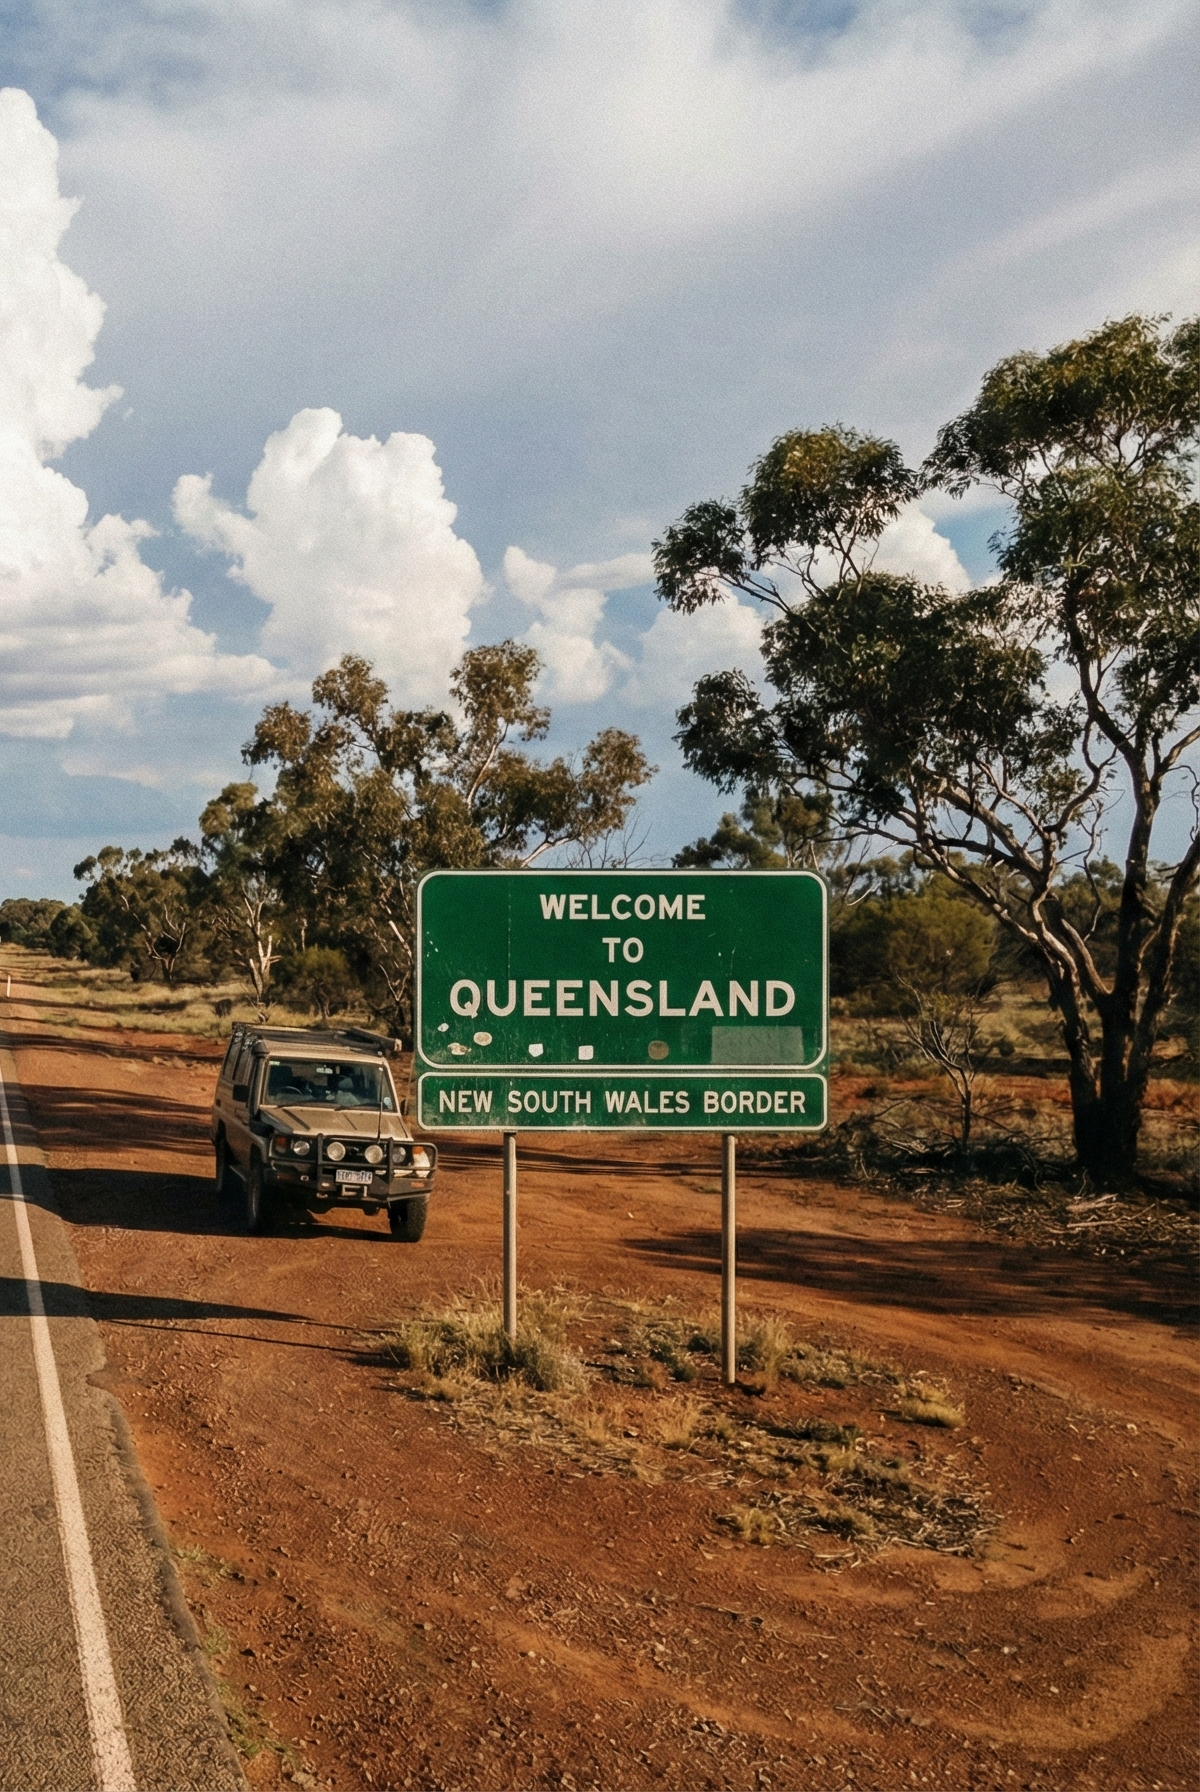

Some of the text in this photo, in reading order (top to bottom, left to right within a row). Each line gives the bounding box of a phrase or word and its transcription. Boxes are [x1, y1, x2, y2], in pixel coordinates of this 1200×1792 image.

[540, 894, 706, 920] WELCOME
[602, 937, 644, 963] TO
[449, 979, 796, 1019] QUEENSLAND
[439, 1090, 806, 1114] NEW SOUTH WALES BORDER
